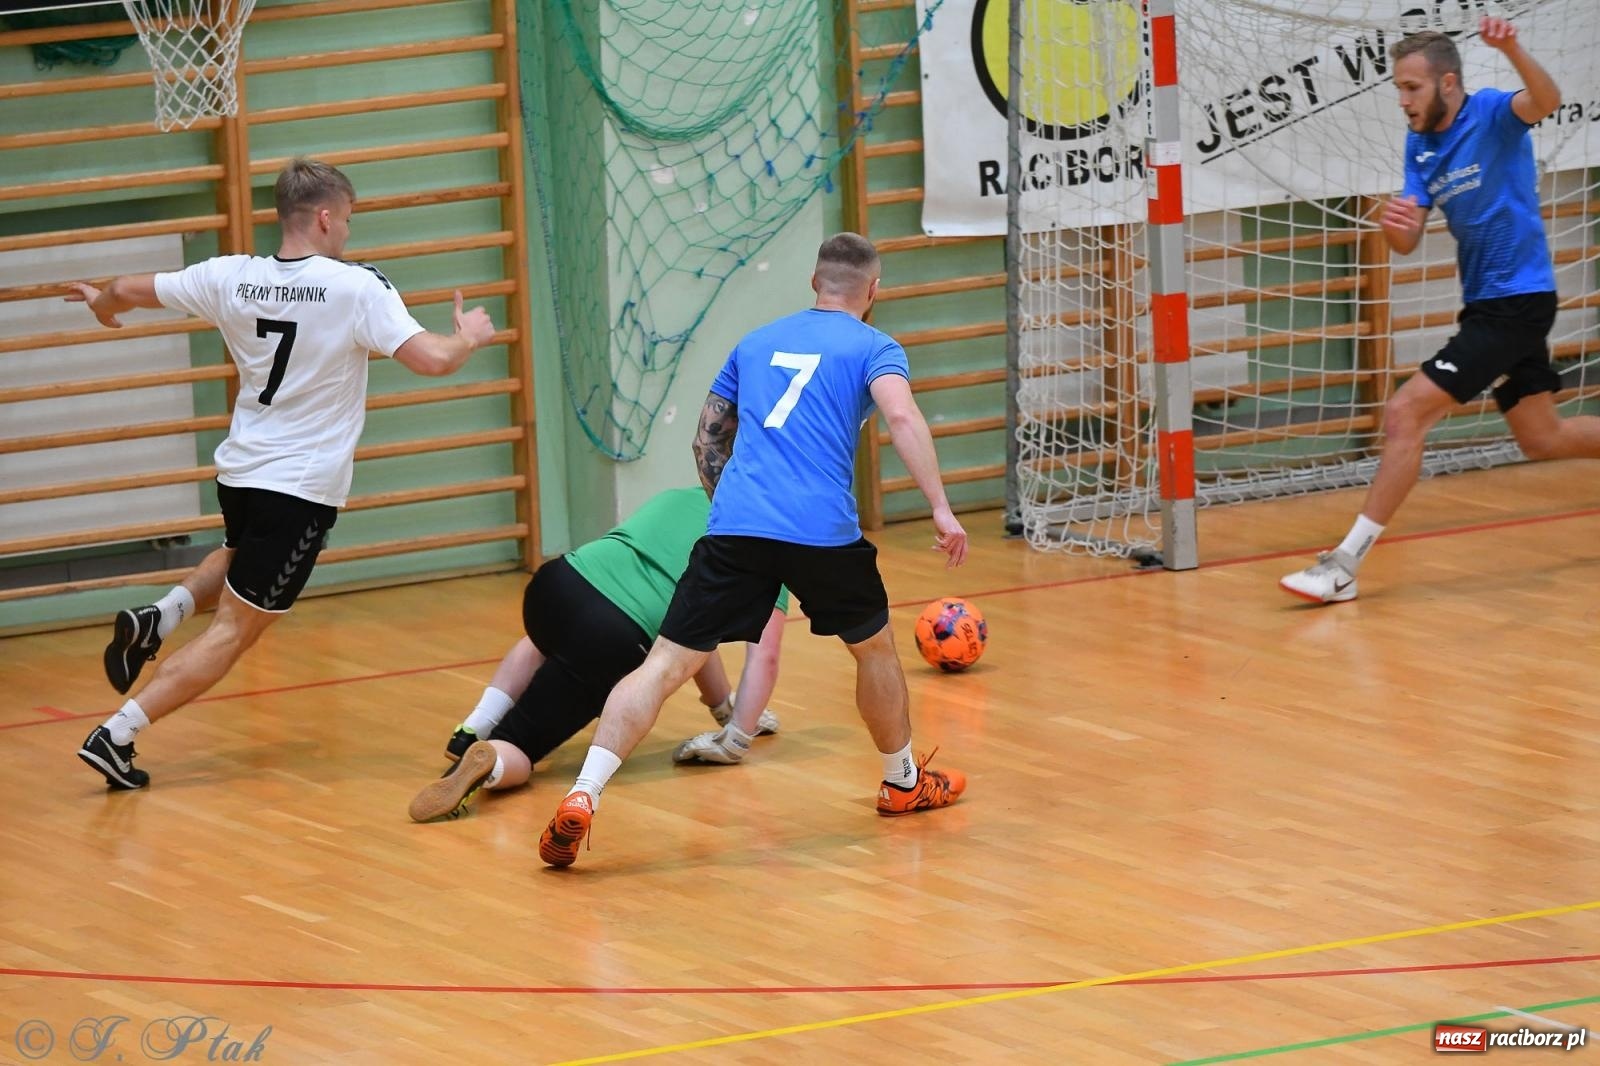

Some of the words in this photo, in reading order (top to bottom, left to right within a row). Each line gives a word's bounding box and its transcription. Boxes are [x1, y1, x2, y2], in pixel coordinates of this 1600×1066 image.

[1196, 56, 1319, 154] JEST
[1334, 29, 1387, 86] W
[236, 283, 272, 303] PIĘKNY
[274, 286, 327, 303] TRAWNIK
[256, 318, 298, 406] 7
[763, 351, 821, 429] 7
